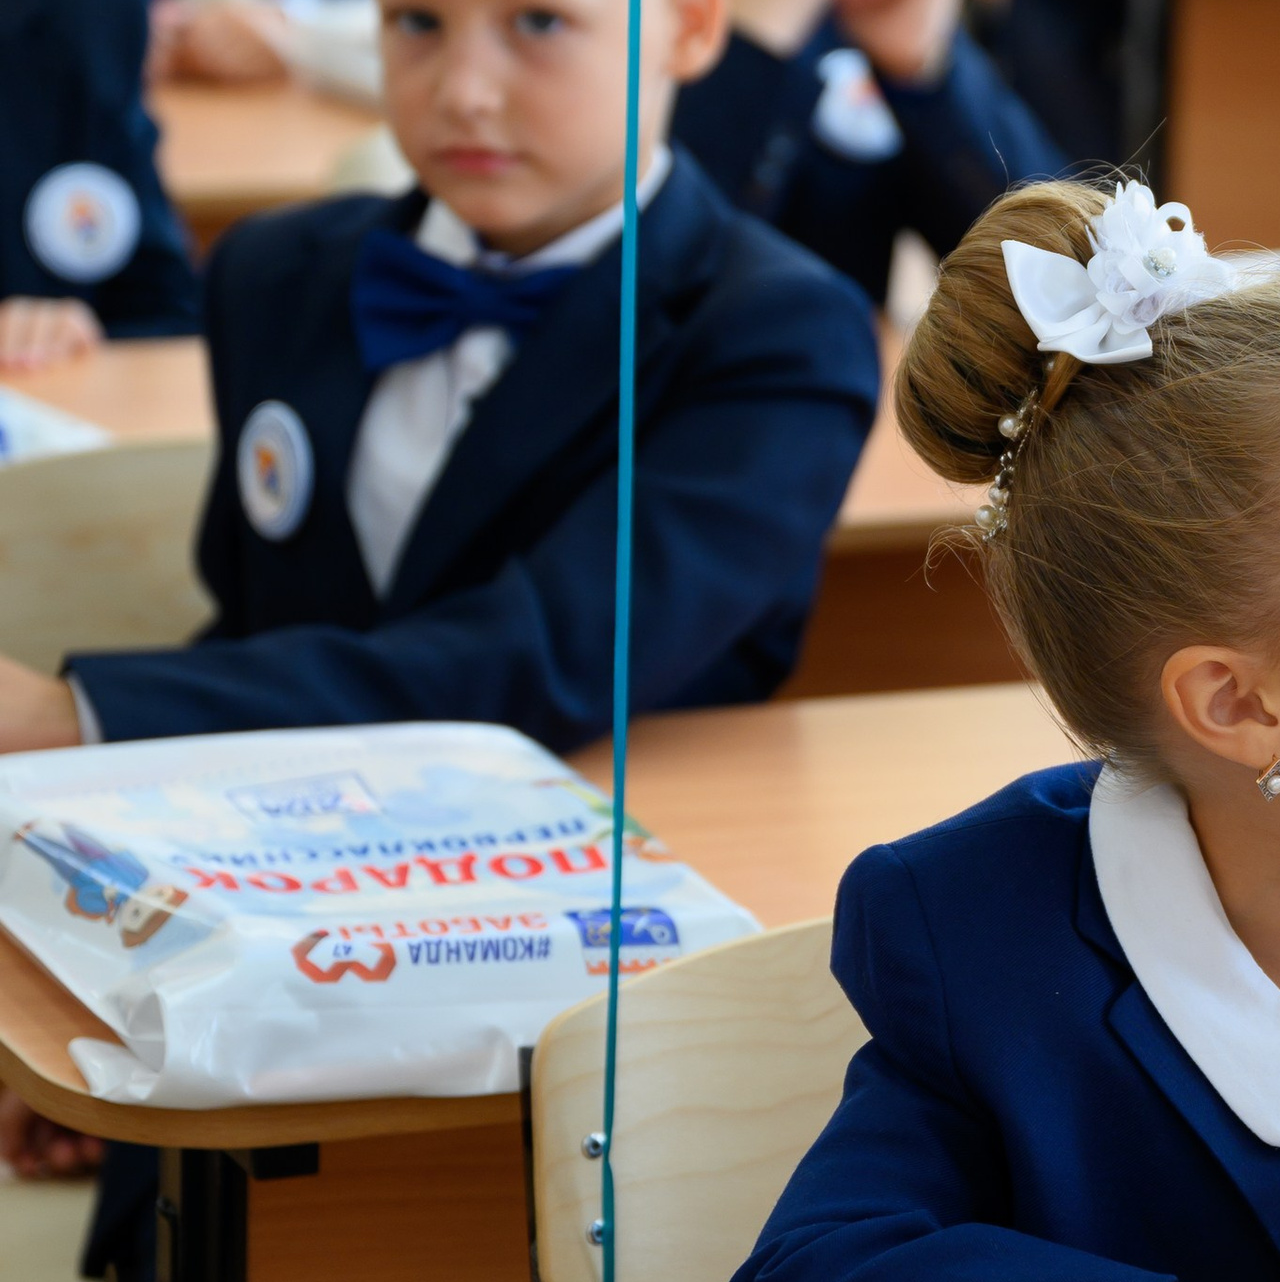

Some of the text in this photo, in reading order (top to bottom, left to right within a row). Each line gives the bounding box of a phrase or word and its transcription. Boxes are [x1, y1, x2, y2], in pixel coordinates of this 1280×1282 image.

[182, 843, 607, 893] ПОДАРОК
[332, 942, 353, 956] 47
[406, 934, 550, 965] #КОМАНДА
